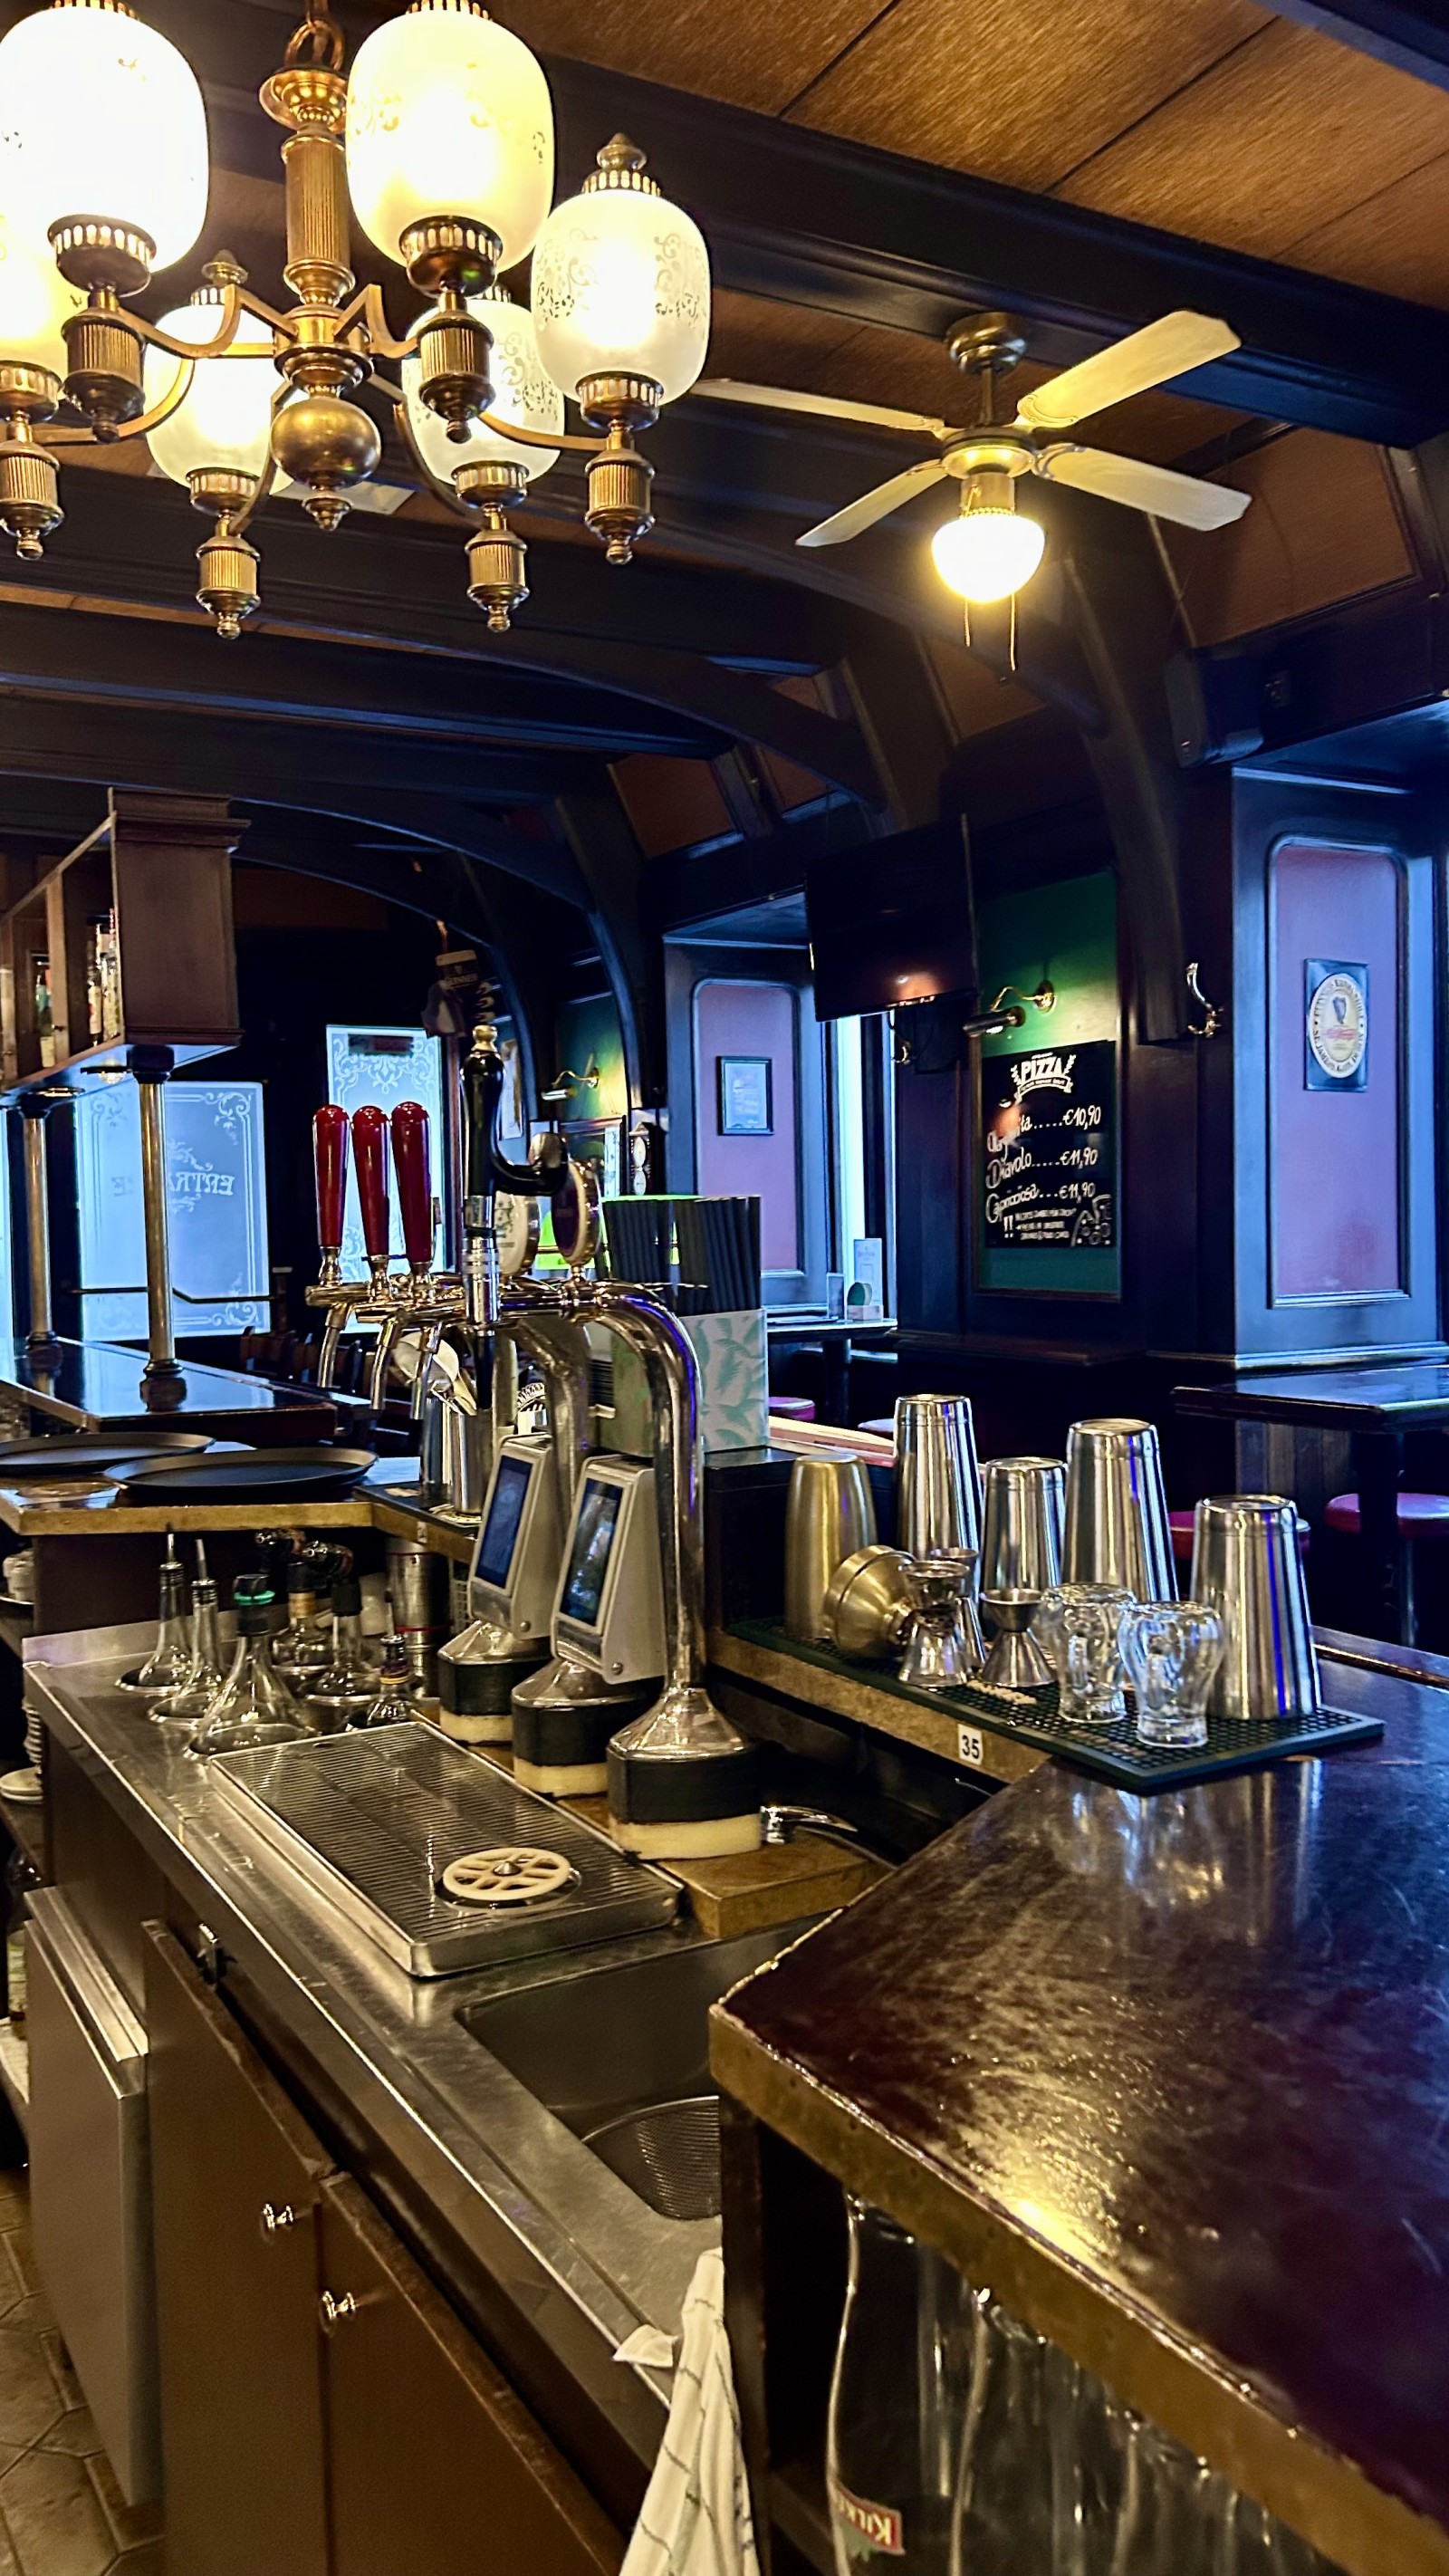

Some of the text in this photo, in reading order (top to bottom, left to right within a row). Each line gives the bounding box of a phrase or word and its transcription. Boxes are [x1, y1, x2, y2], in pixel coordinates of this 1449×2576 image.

[1021, 1055, 1063, 1084] PIZZA
[1062, 1104, 1101, 1130] €10,90
[985, 1146, 1099, 1189] Diavolo €11,90
[1059, 1181, 1096, 1204] €11,90
[962, 1734, 980, 1760] 35
